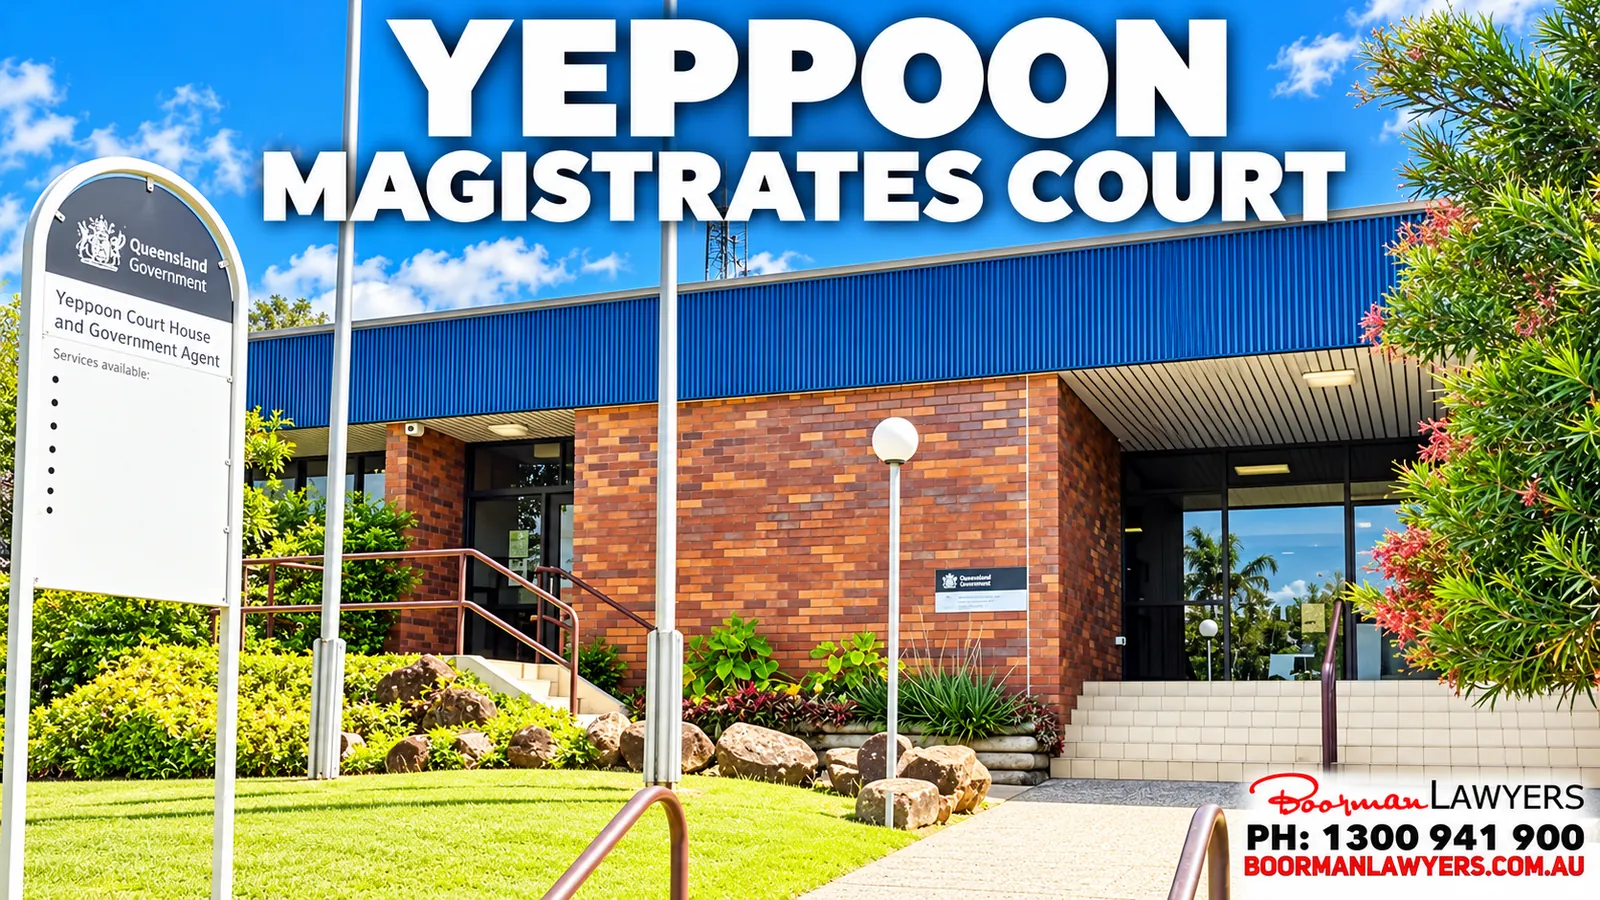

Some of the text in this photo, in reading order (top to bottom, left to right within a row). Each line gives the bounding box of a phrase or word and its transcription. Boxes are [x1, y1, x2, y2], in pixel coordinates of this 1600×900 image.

[129, 238, 208, 273] Queensland
[129, 258, 207, 293] Government
[55, 289, 211, 344] Yeppoon Court House
[54, 315, 220, 368] and Government Agent
[53, 348, 150, 380] Services available:
